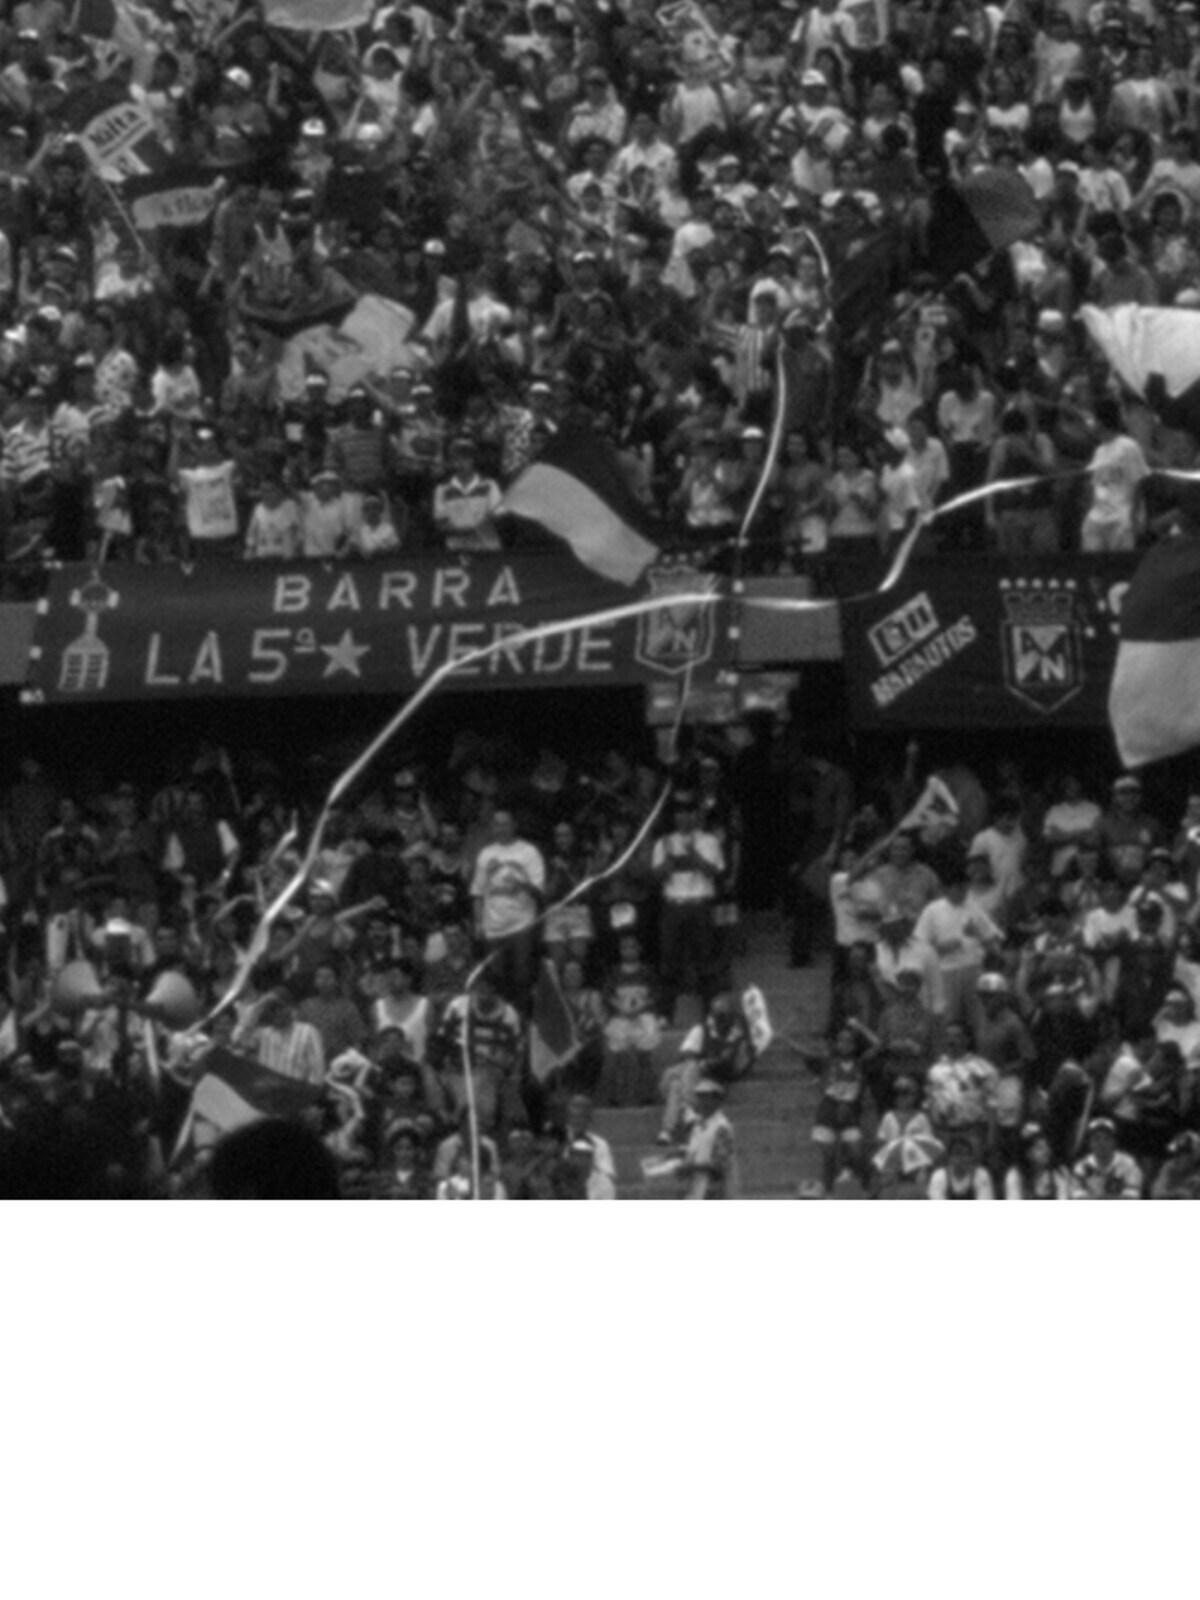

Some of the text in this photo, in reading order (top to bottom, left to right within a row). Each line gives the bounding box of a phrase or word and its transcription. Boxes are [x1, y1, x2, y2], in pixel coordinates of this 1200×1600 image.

[273, 566, 520, 613] BARRA
[145, 630, 223, 684] LA
[407, 622, 615, 677] VERDE
